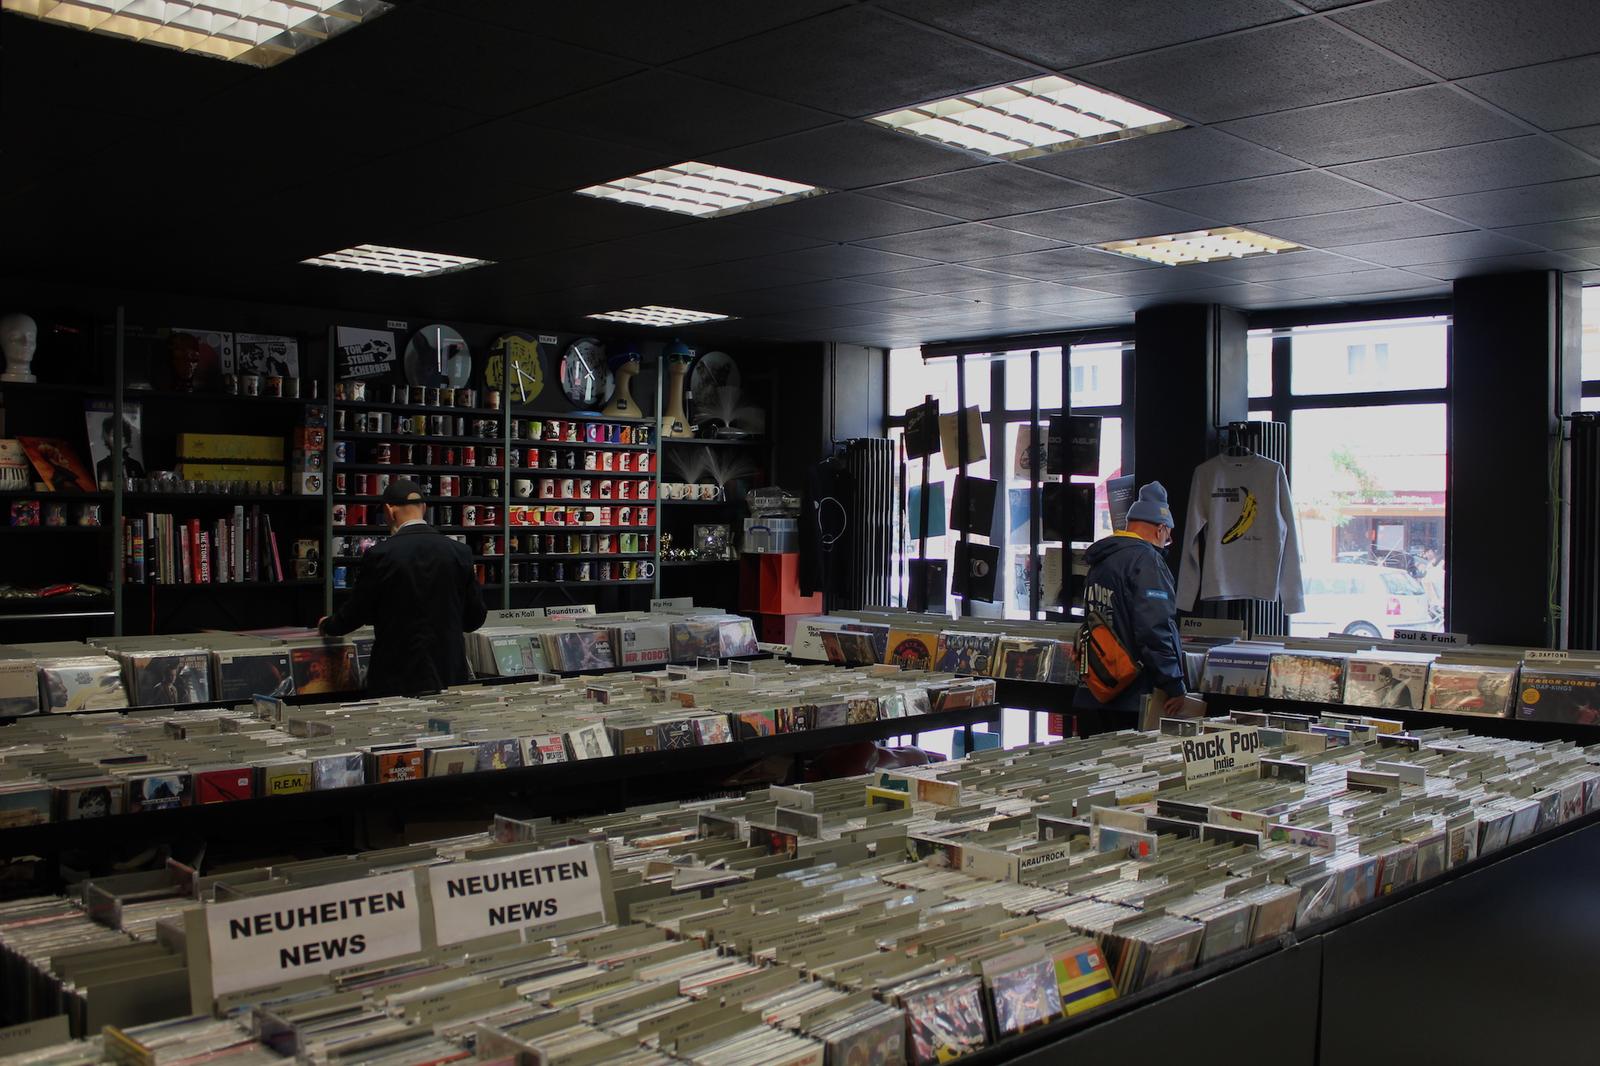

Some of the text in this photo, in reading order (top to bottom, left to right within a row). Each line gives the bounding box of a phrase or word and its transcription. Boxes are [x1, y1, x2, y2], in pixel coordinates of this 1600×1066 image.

[1184, 619, 1202, 627] Afro
[1394, 631, 1457, 644] Soul & Funk
[1182, 731, 1259, 763] Rock Pop
[1213, 756, 1235, 770] Indie
[274, 778, 304, 790] R.E.M.
[1021, 850, 1065, 868] KRAUTROCK
[447, 860, 588, 898] NEUHEITEN
[230, 890, 405, 939] NEUHEITEN
[489, 898, 558, 926] NEWS
[280, 934, 366, 968] NEWS
